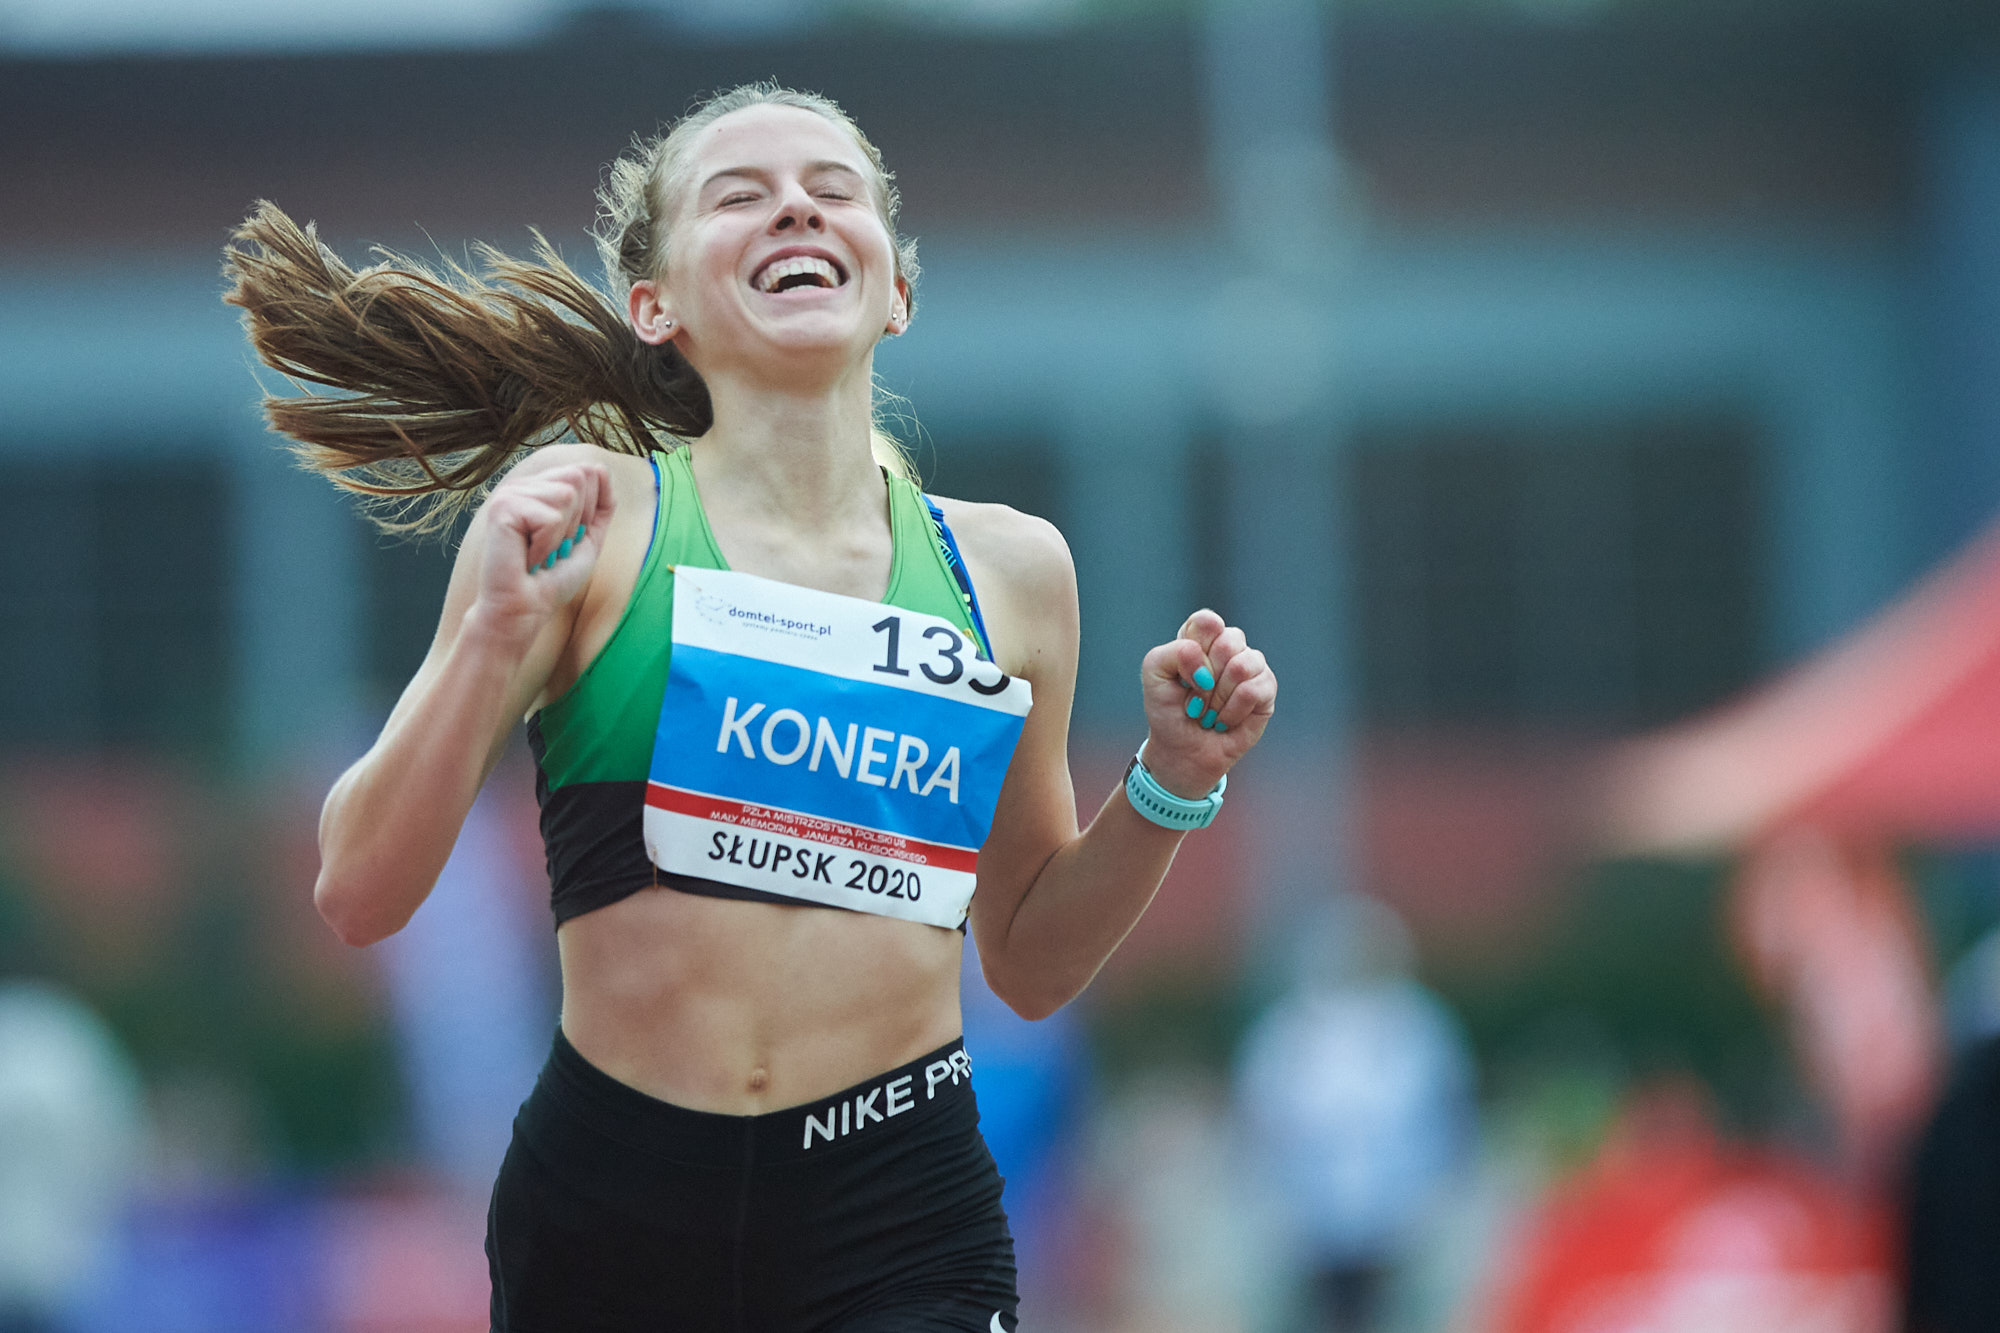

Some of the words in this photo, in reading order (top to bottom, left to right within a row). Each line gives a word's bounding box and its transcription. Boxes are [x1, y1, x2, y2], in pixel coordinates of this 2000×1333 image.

[729, 607, 832, 636] domtel-sport.pl
[716, 696, 961, 805] KONERA
[742, 805, 771, 818] PZLA
[773, 811, 853, 837] MISTRZOSTWA
[855, 829, 893, 845] POLSKI
[802, 830, 855, 849] JANUSZA
[707, 831, 837, 884] SŁUPSK
[844, 860, 922, 902] 2020
[803, 1074, 915, 1150] NIKE
[925, 1045, 972, 1100] PR
